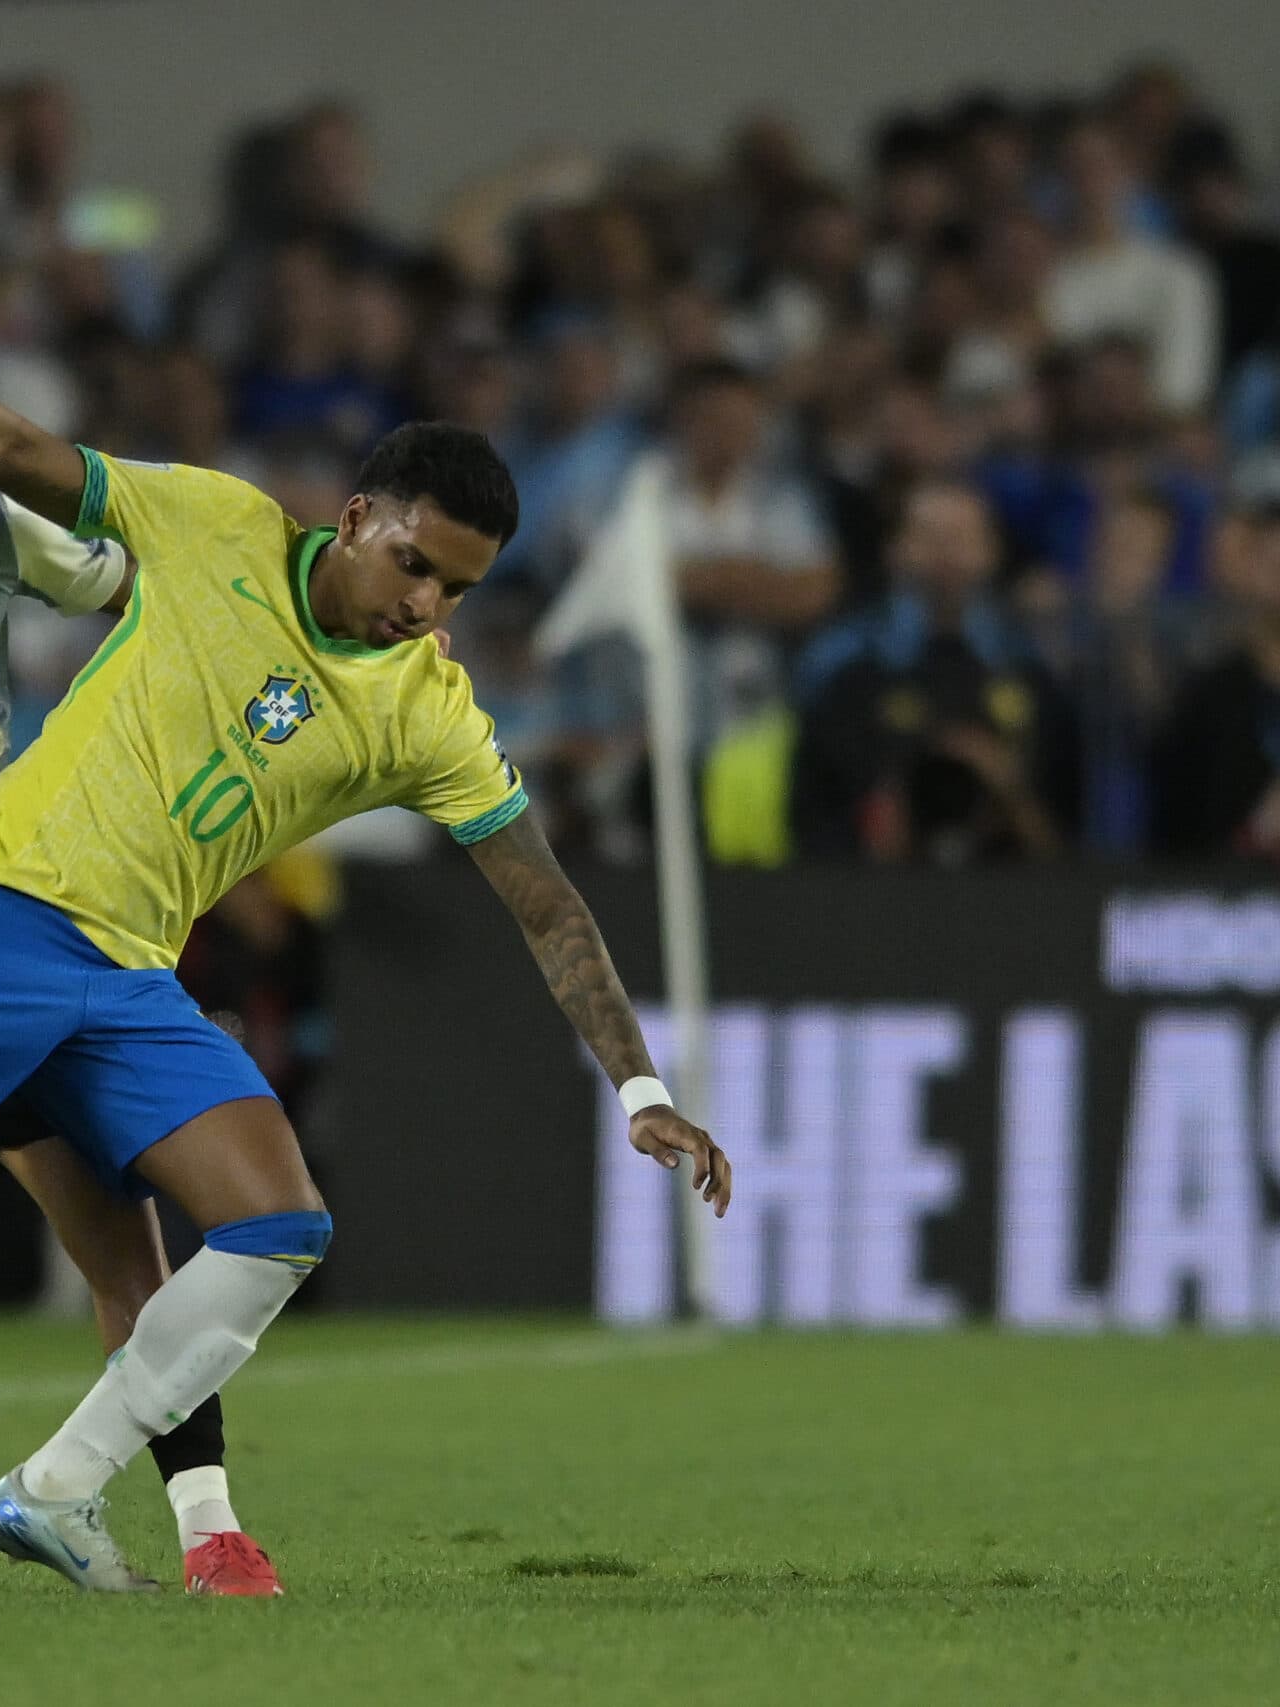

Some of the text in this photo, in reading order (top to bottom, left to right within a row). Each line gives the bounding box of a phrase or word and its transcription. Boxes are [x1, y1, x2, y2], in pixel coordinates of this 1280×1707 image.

[269, 699, 290, 719] CBF
[227, 723, 271, 773] BRASIL
[170, 747, 254, 843] 10
[582, 1004, 1280, 1328] THE LA
